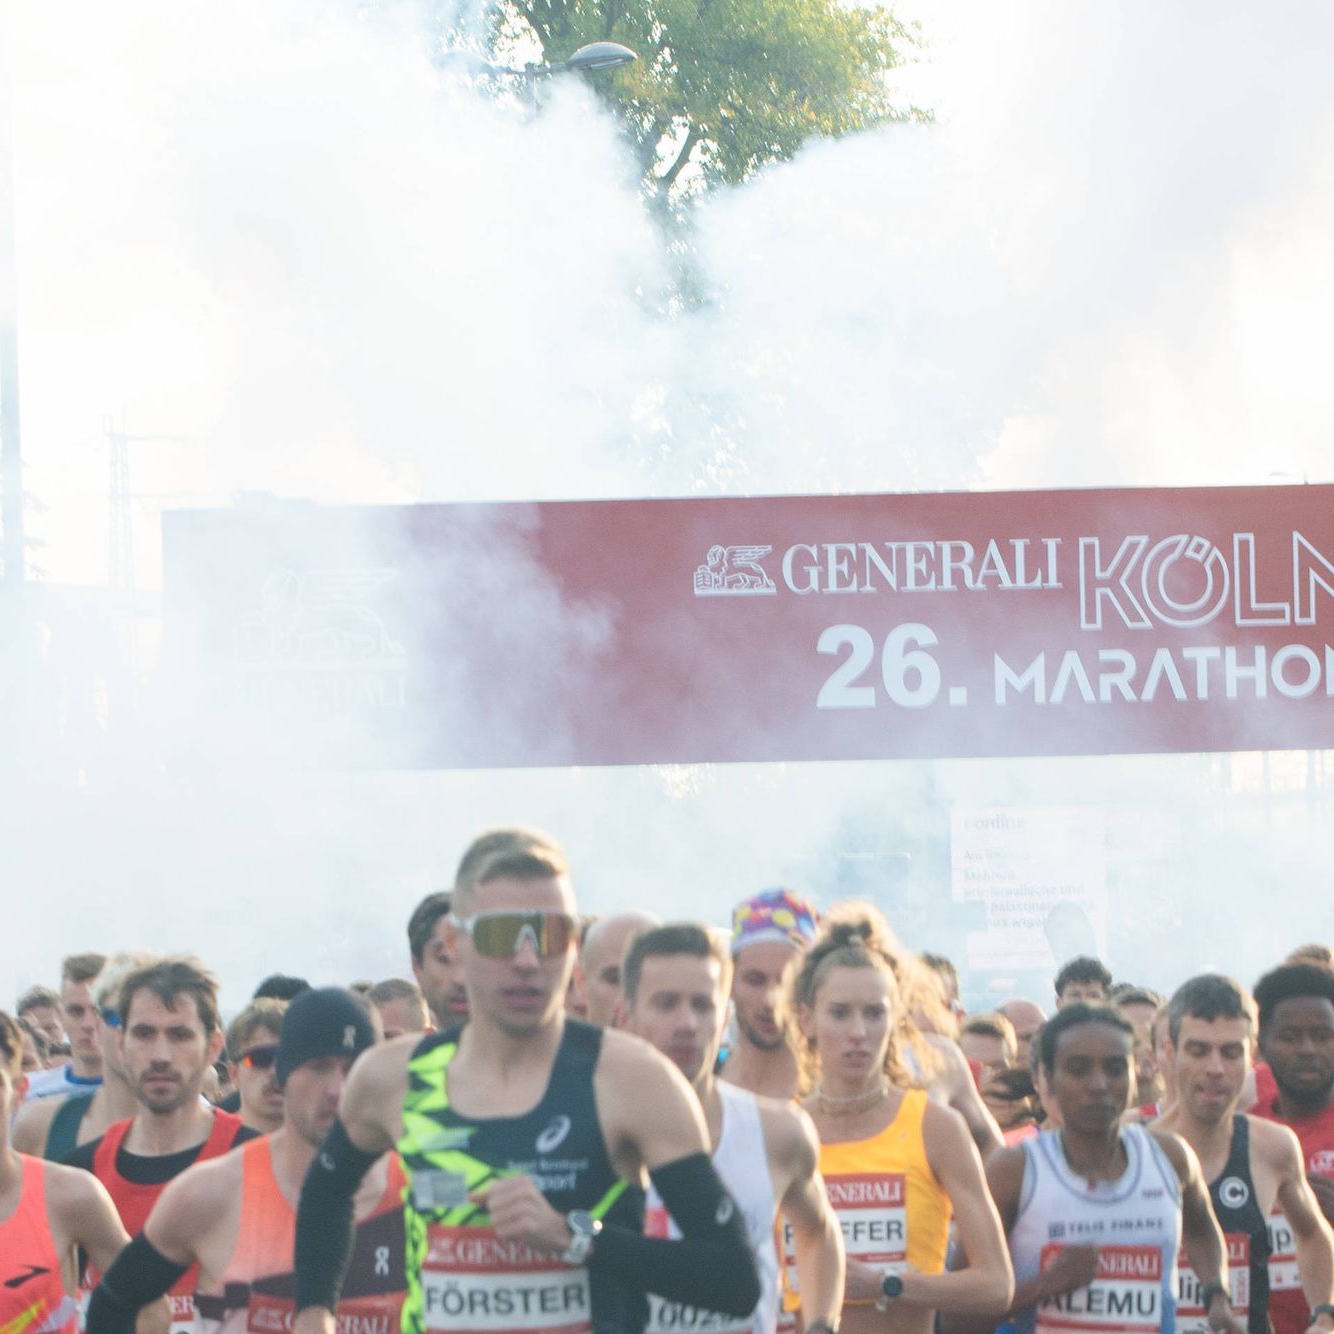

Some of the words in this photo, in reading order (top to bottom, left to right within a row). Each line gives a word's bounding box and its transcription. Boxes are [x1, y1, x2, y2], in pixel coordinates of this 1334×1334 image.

[782, 538, 1063, 594] GENERALI
[816, 623, 969, 709] 26.
[425, 1279, 587, 1316] FÖRSTER
